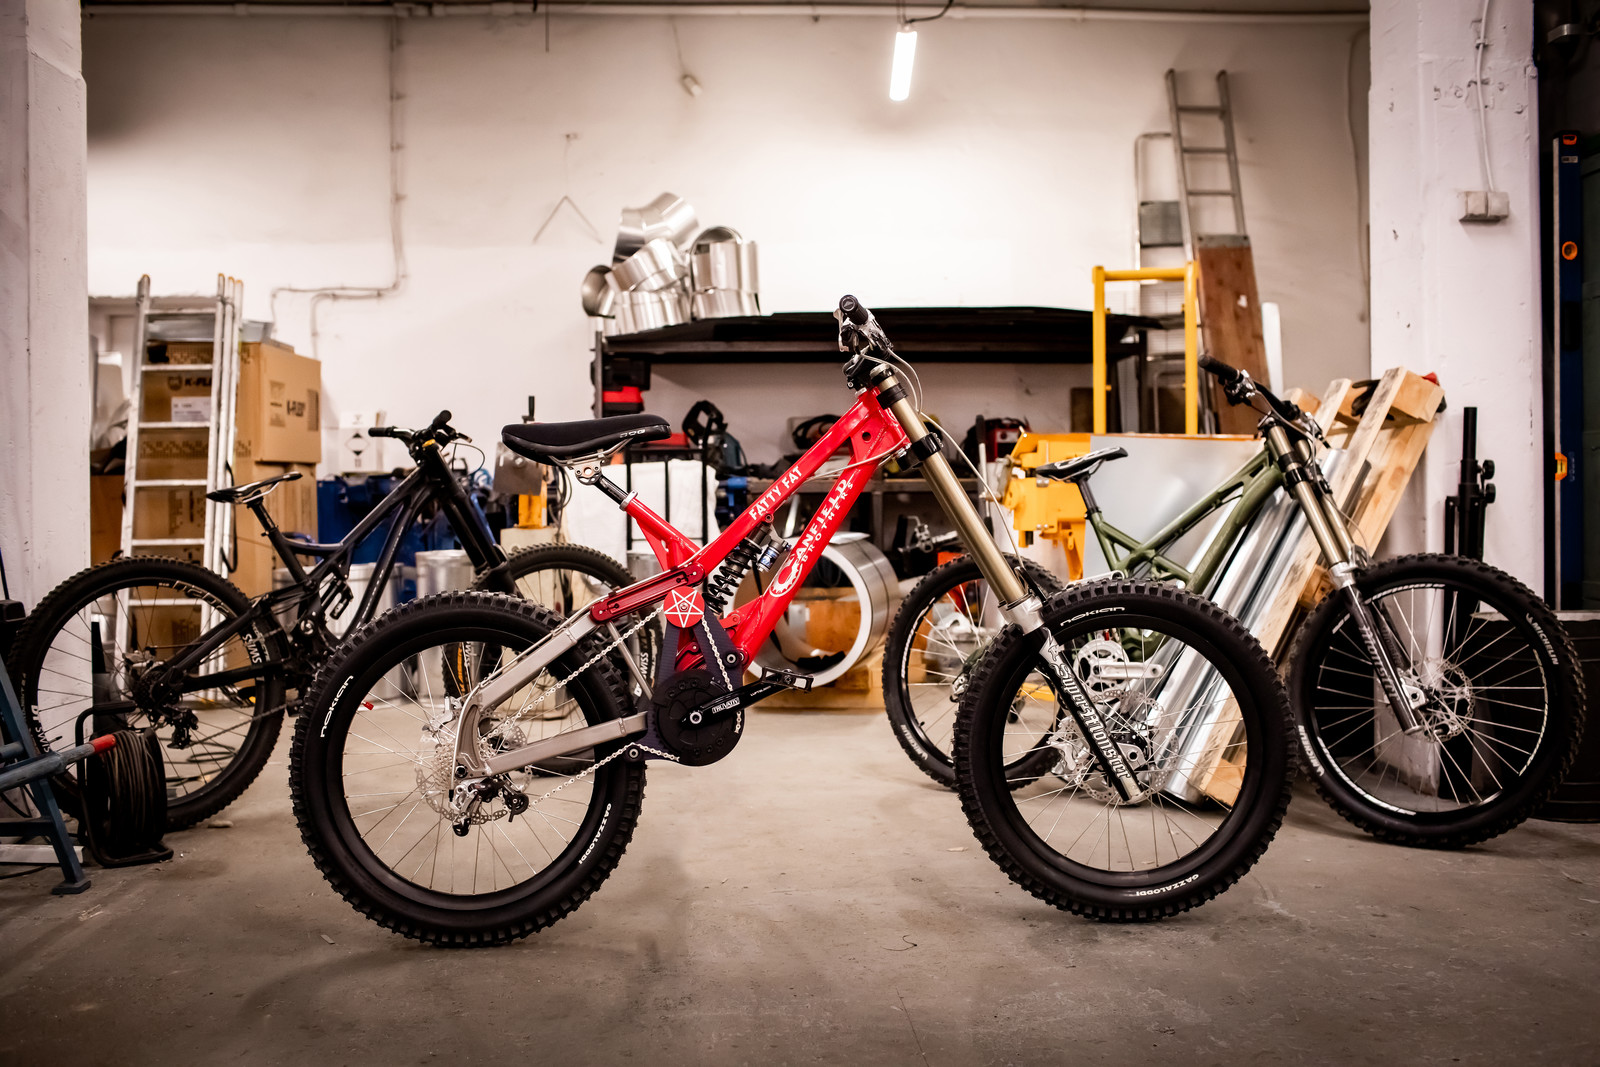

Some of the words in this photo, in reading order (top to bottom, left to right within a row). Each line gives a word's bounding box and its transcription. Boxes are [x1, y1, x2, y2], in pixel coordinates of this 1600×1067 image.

[748, 485, 783, 521] FATTY
[781, 465, 803, 489] FAT
[800, 481, 854, 563] BROTHERS
[1531, 621, 1559, 665] MICHELIN
[1298, 724, 1320, 769] MICHELIN
[578, 802, 612, 865] GAZZALODDI
[1136, 873, 1199, 897] GAZZALODDI
